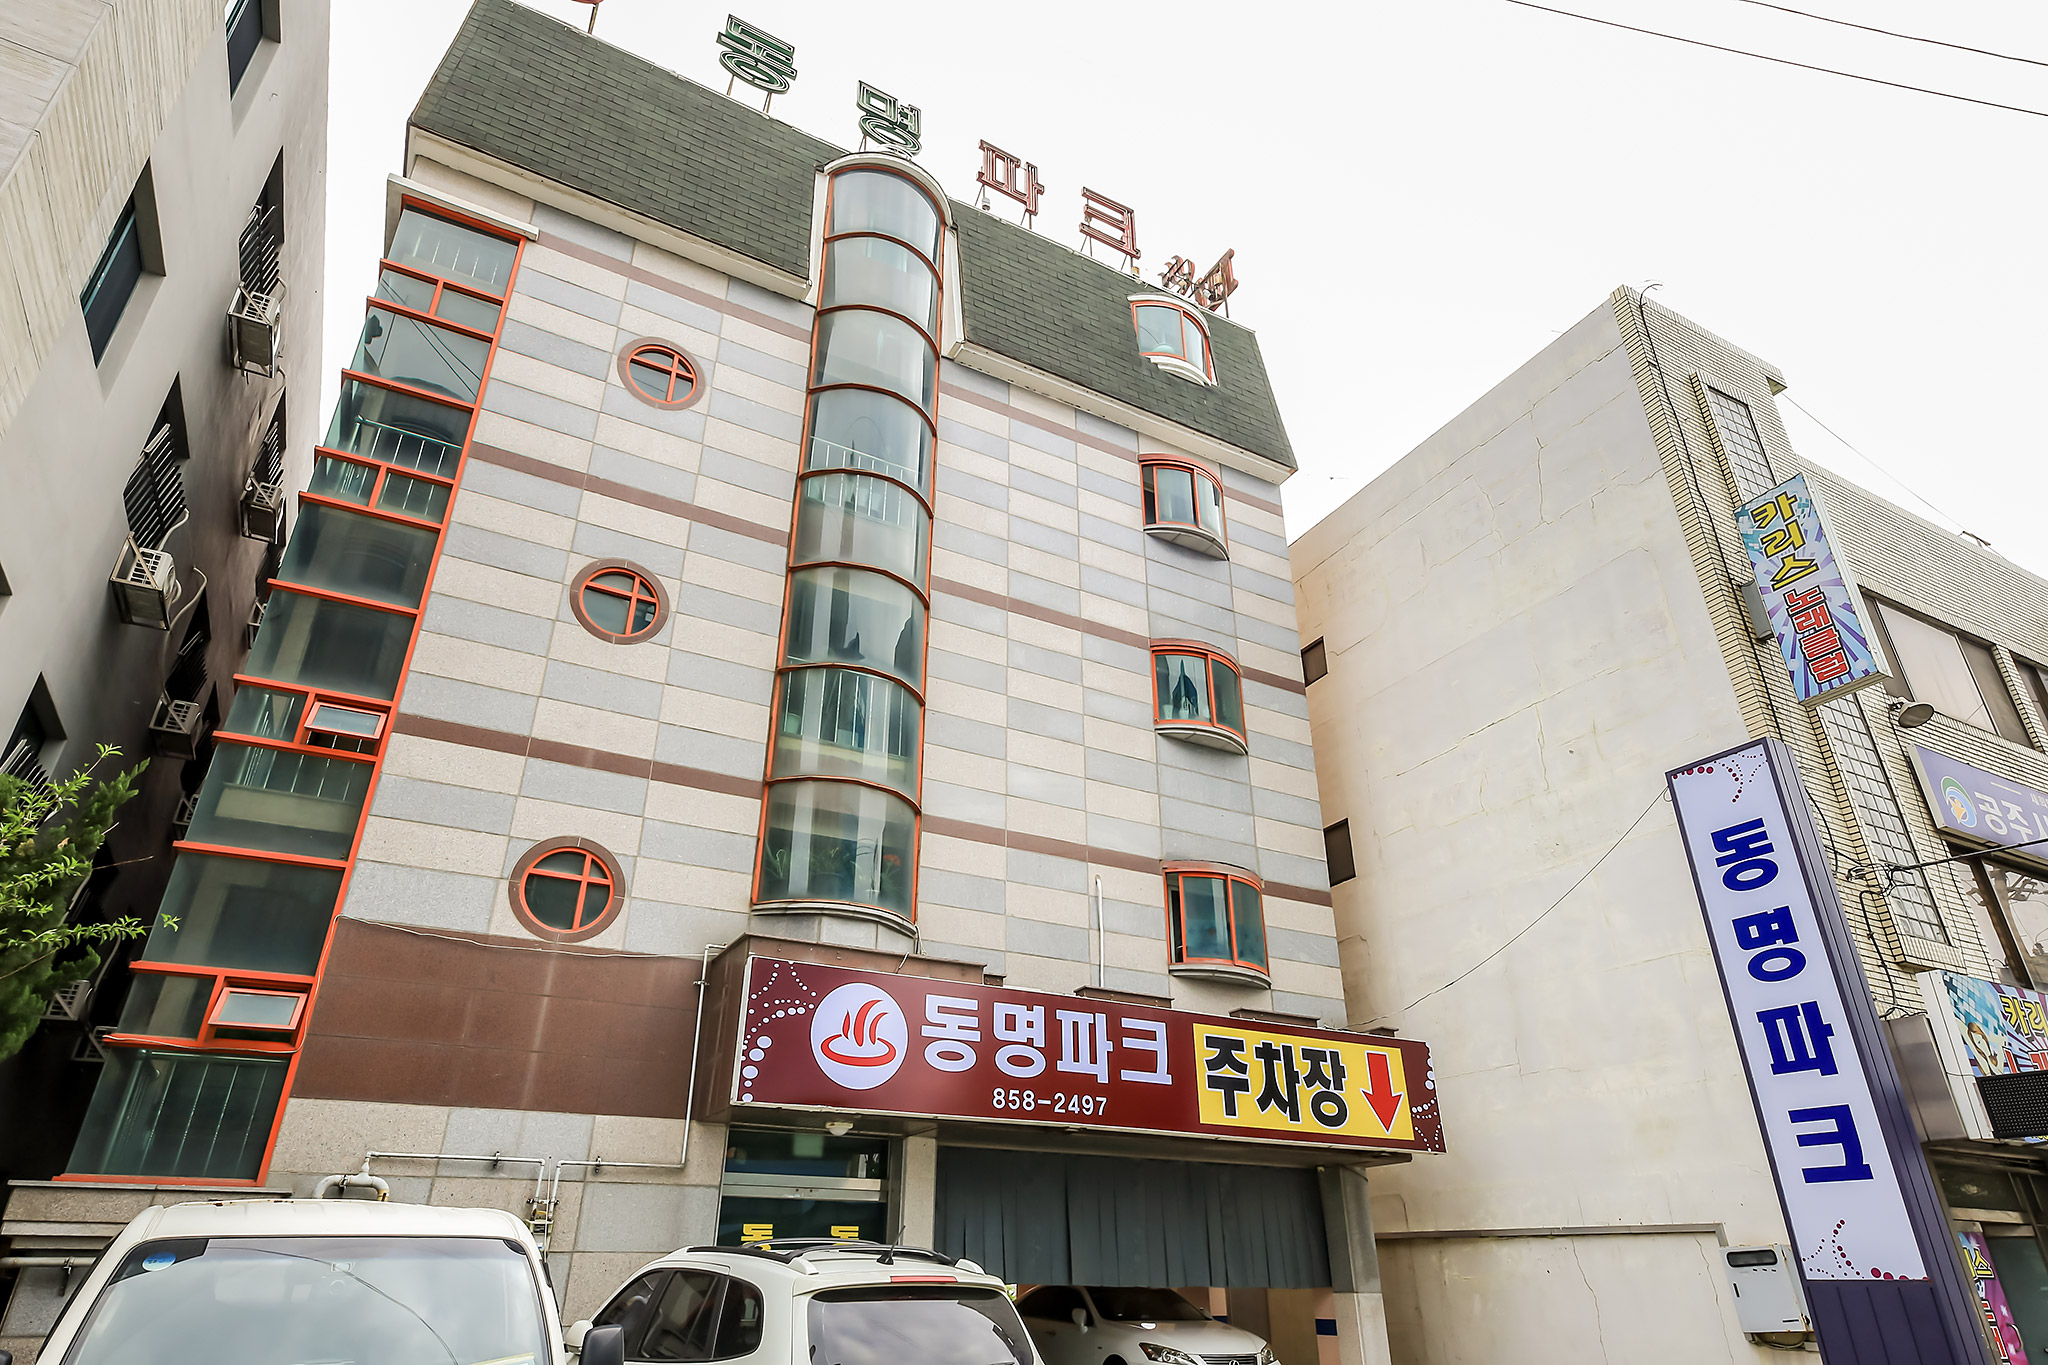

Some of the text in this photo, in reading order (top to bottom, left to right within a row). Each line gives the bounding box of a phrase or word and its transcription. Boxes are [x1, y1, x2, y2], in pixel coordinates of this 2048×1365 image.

[1750, 490, 1820, 592] 카리스
[1709, 816, 1875, 1184] 동명파크
[919, 992, 1347, 1130] 동명파크 주차장
[991, 1087, 1109, 1117] 858-2497
